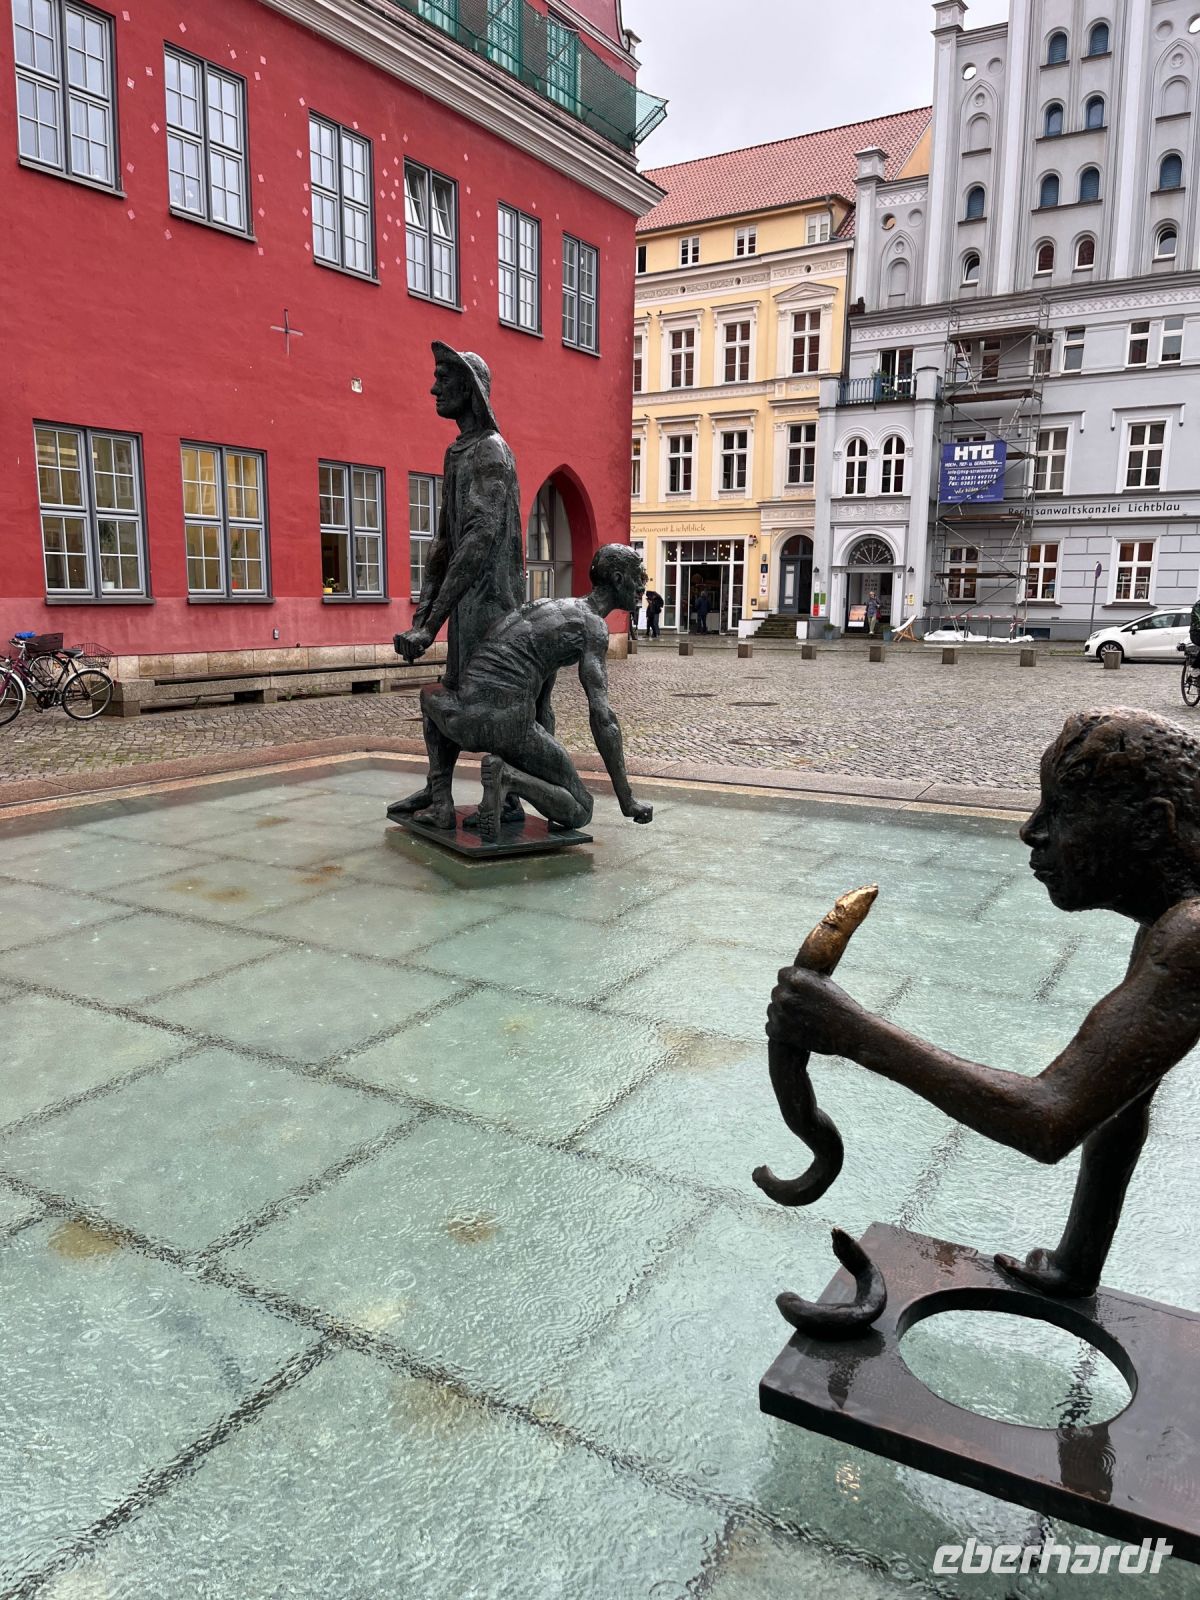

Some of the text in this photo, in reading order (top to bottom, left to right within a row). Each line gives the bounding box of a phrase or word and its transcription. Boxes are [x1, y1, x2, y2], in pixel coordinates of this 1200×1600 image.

[954, 444, 995, 461] HTG
[1008, 501, 1180, 516] Rechtsanwaltskanzlei Lichtblau
[631, 523, 706, 533] Restaurant Lichtblick
